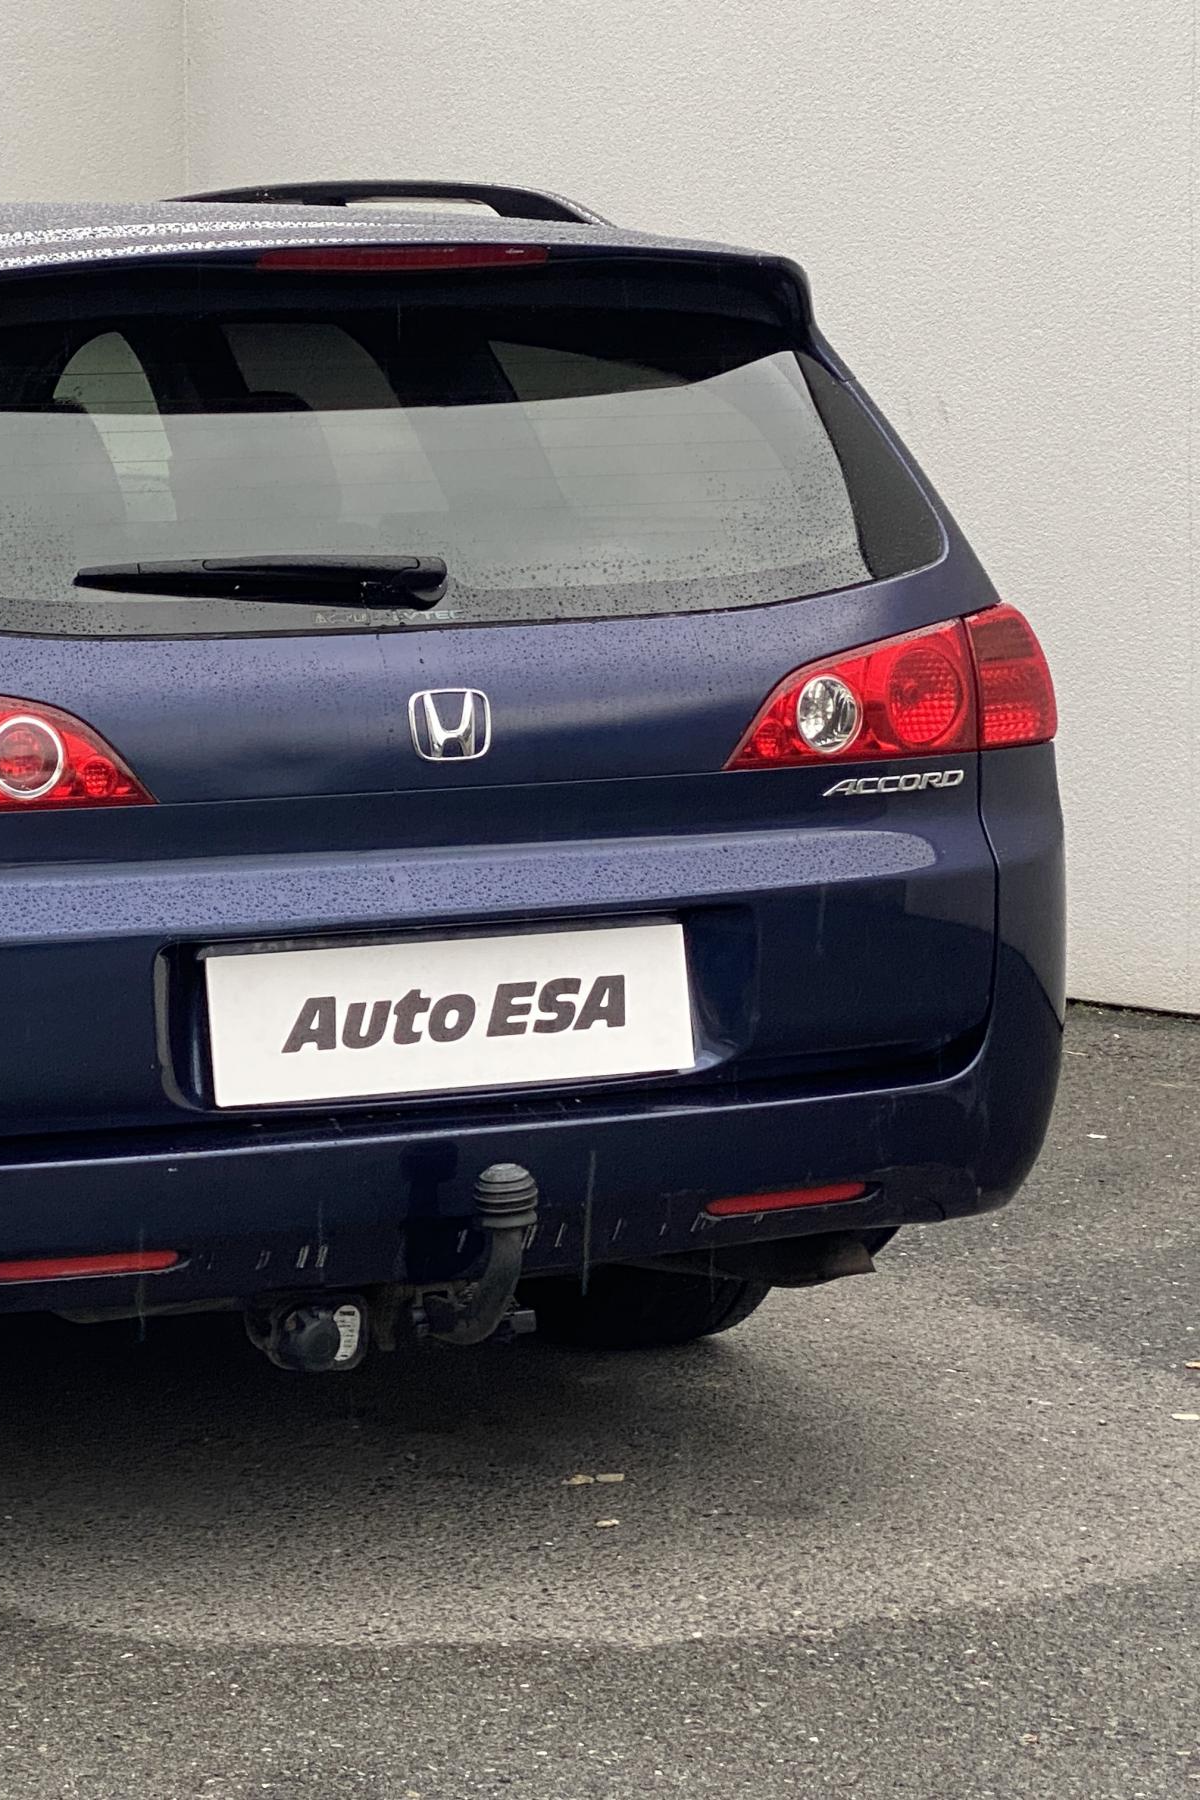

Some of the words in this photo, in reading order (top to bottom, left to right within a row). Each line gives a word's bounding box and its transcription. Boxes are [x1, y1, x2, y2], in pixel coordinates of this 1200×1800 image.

[822, 769, 964, 797] ACCORD
[281, 989, 476, 1053] Auto
[486, 974, 626, 1037] ESA
